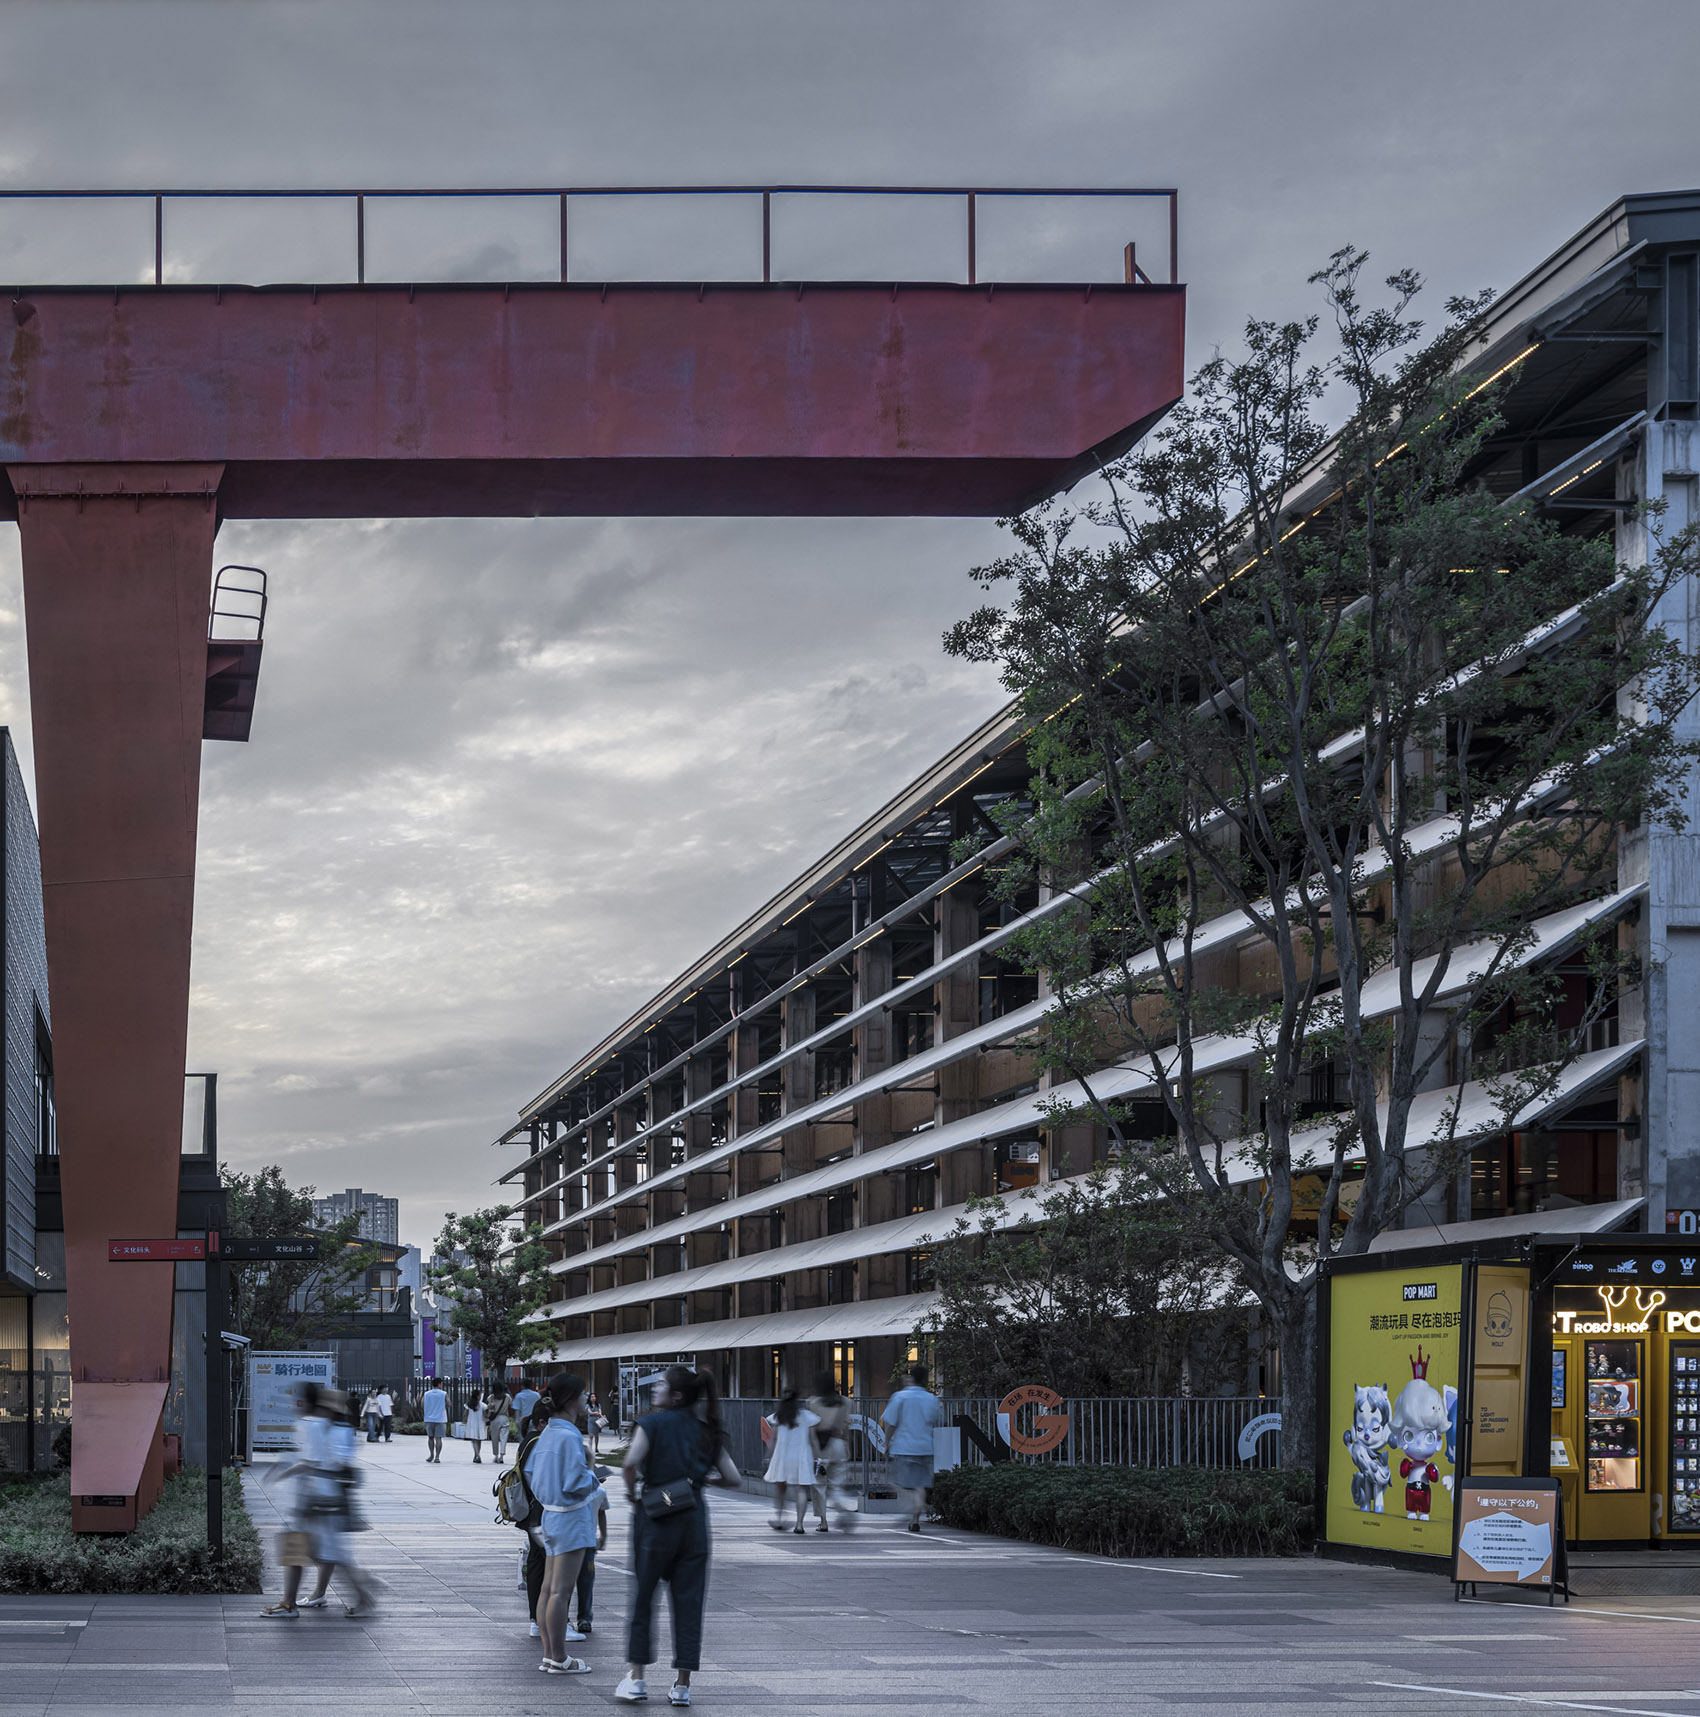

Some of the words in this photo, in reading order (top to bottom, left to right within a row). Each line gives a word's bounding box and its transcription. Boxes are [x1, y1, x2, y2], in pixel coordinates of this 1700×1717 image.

[1679, 1211, 1700, 1234] 0
[123, 1246, 150, 1254] 文化码头
[275, 1245, 302, 1253] 文化山谷
[1572, 1260, 1594, 1272] DIMOO
[1403, 1286, 1417, 1300] POP
[1418, 1284, 1436, 1298] MART
[1370, 1314, 1408, 1331] 潮流玩具
[1574, 1322, 1612, 1334] ROBO
[1612, 1322, 1649, 1334] SHOP
[275, 1363, 327, 1377] 騎行地圖
[1027, 1389, 1051, 1402] 在发生
